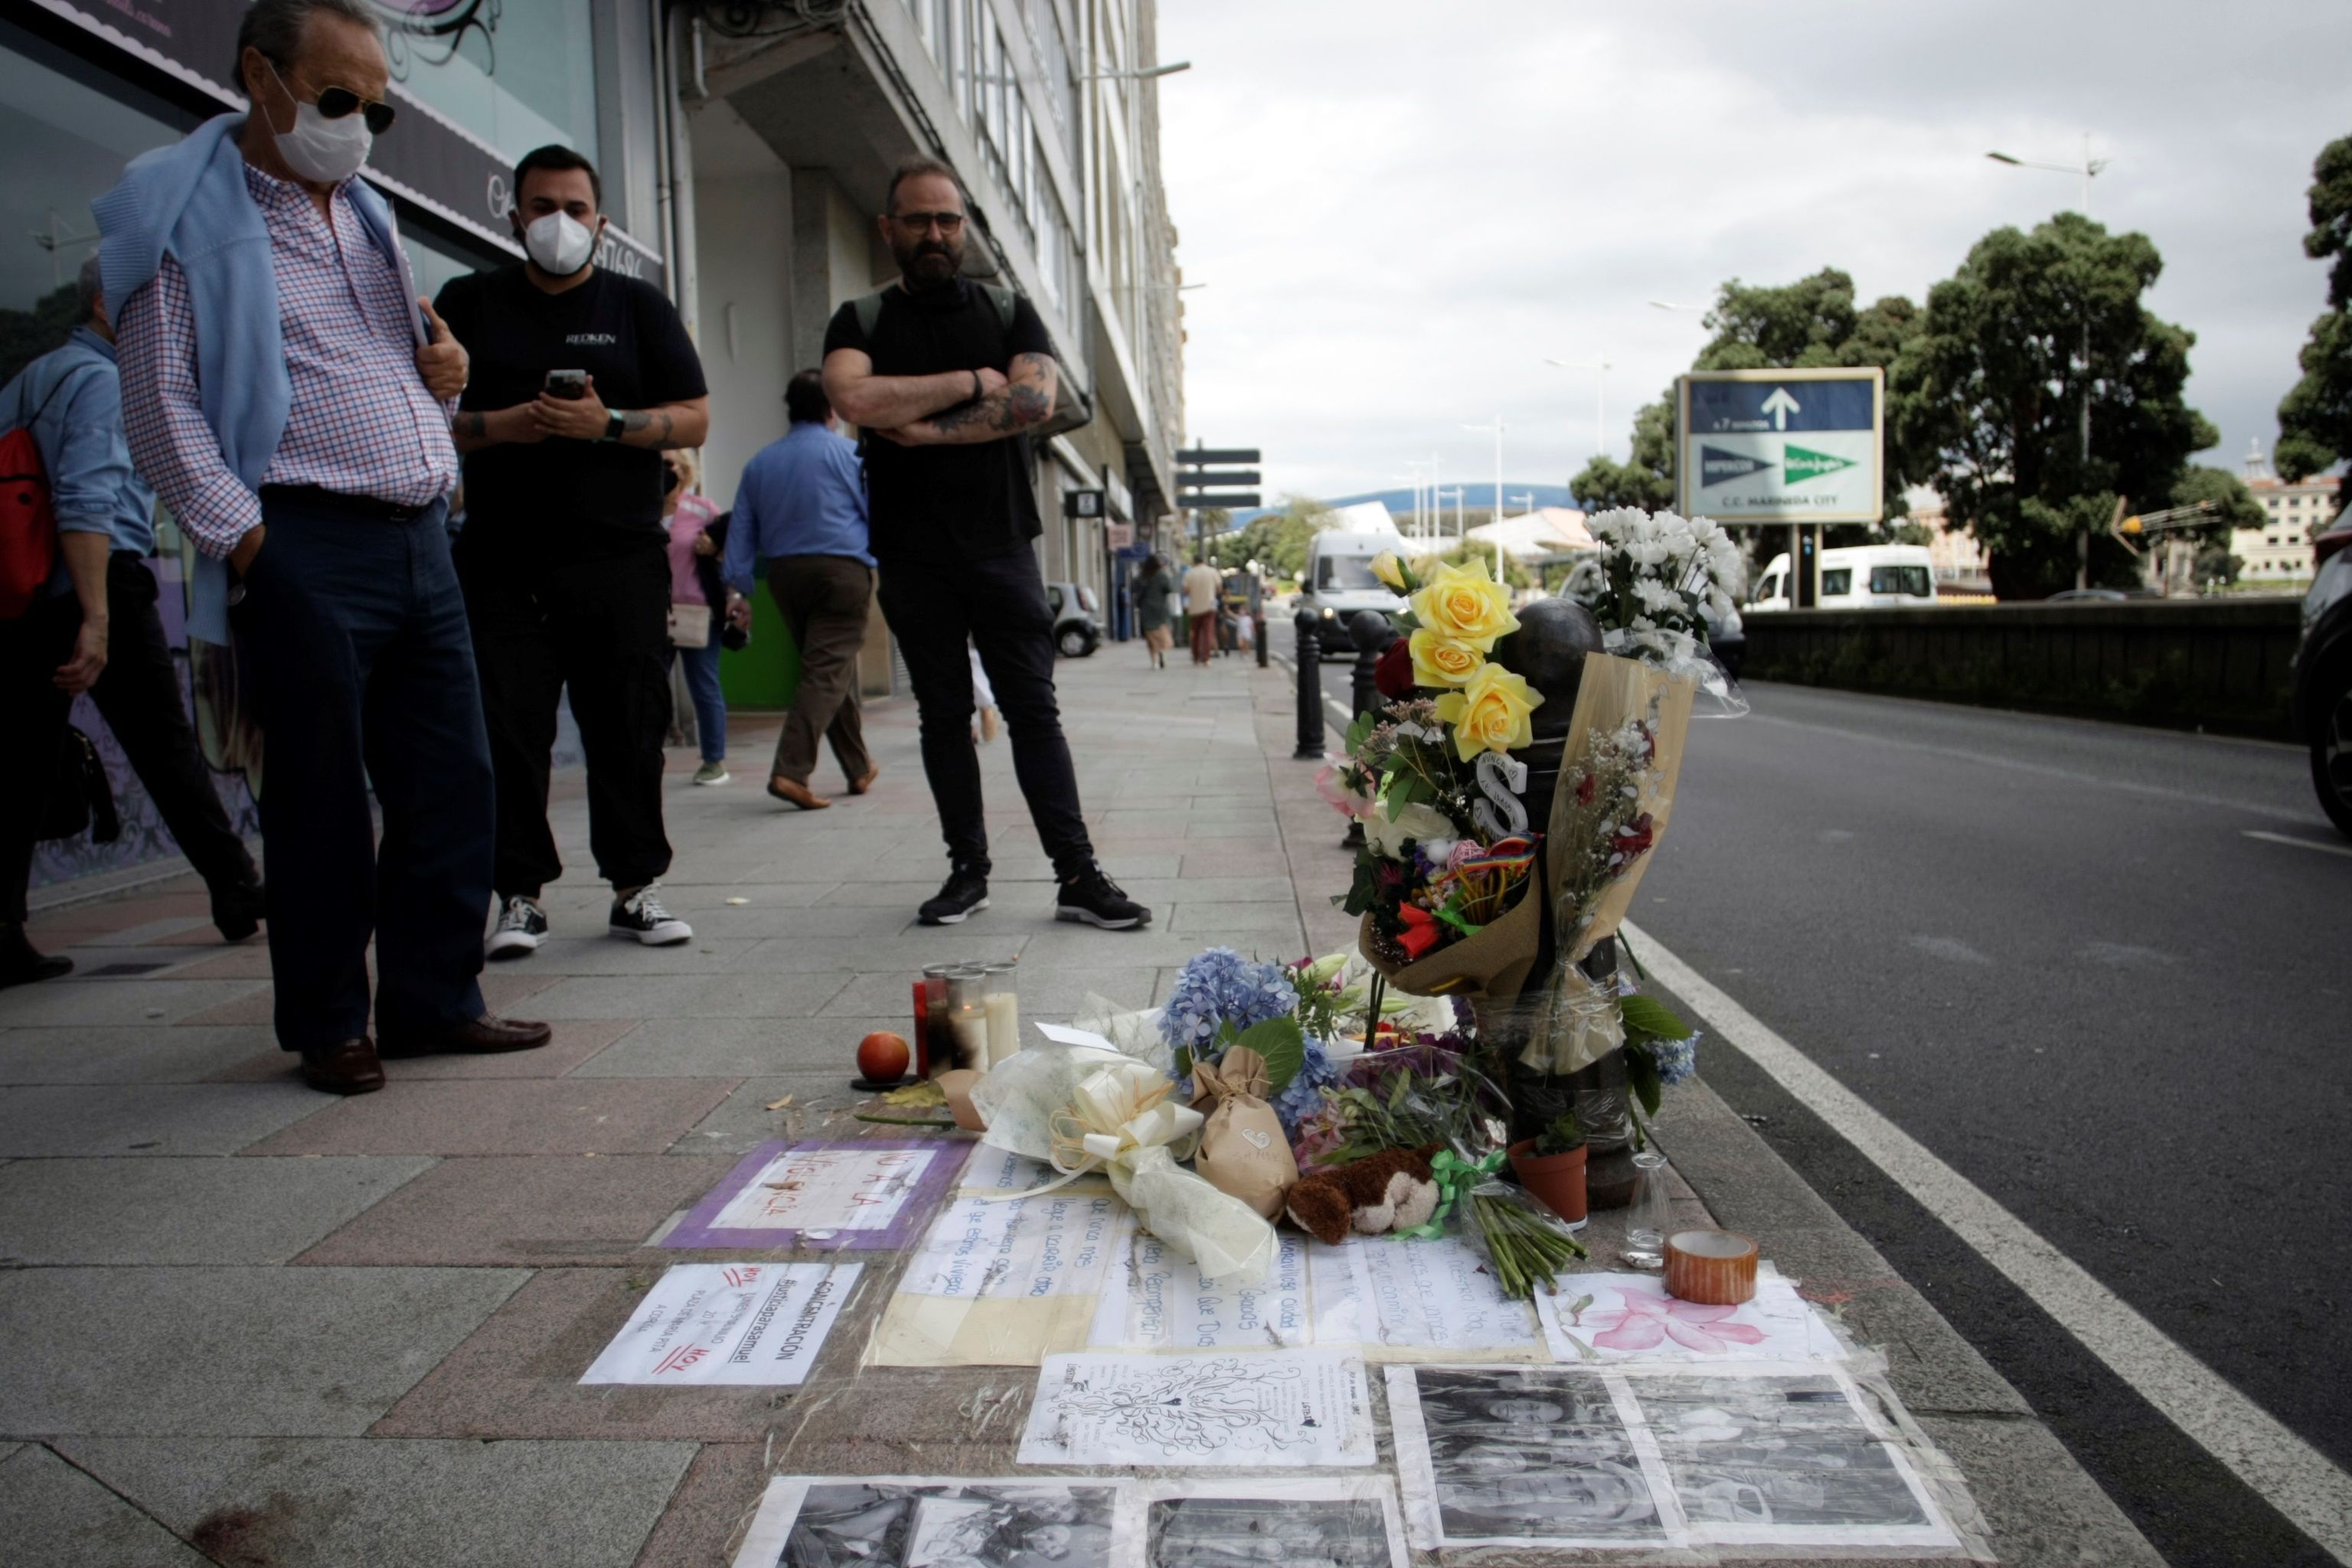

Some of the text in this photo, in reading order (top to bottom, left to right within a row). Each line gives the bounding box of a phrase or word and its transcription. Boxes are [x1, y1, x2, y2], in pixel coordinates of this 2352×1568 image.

[740, 1267, 761, 1282] HOY
[733, 1279, 797, 1363] #justiciaparasamuel
[776, 1282, 834, 1360] CONCENTRACIÓN
[671, 1348, 710, 1371] HOY
